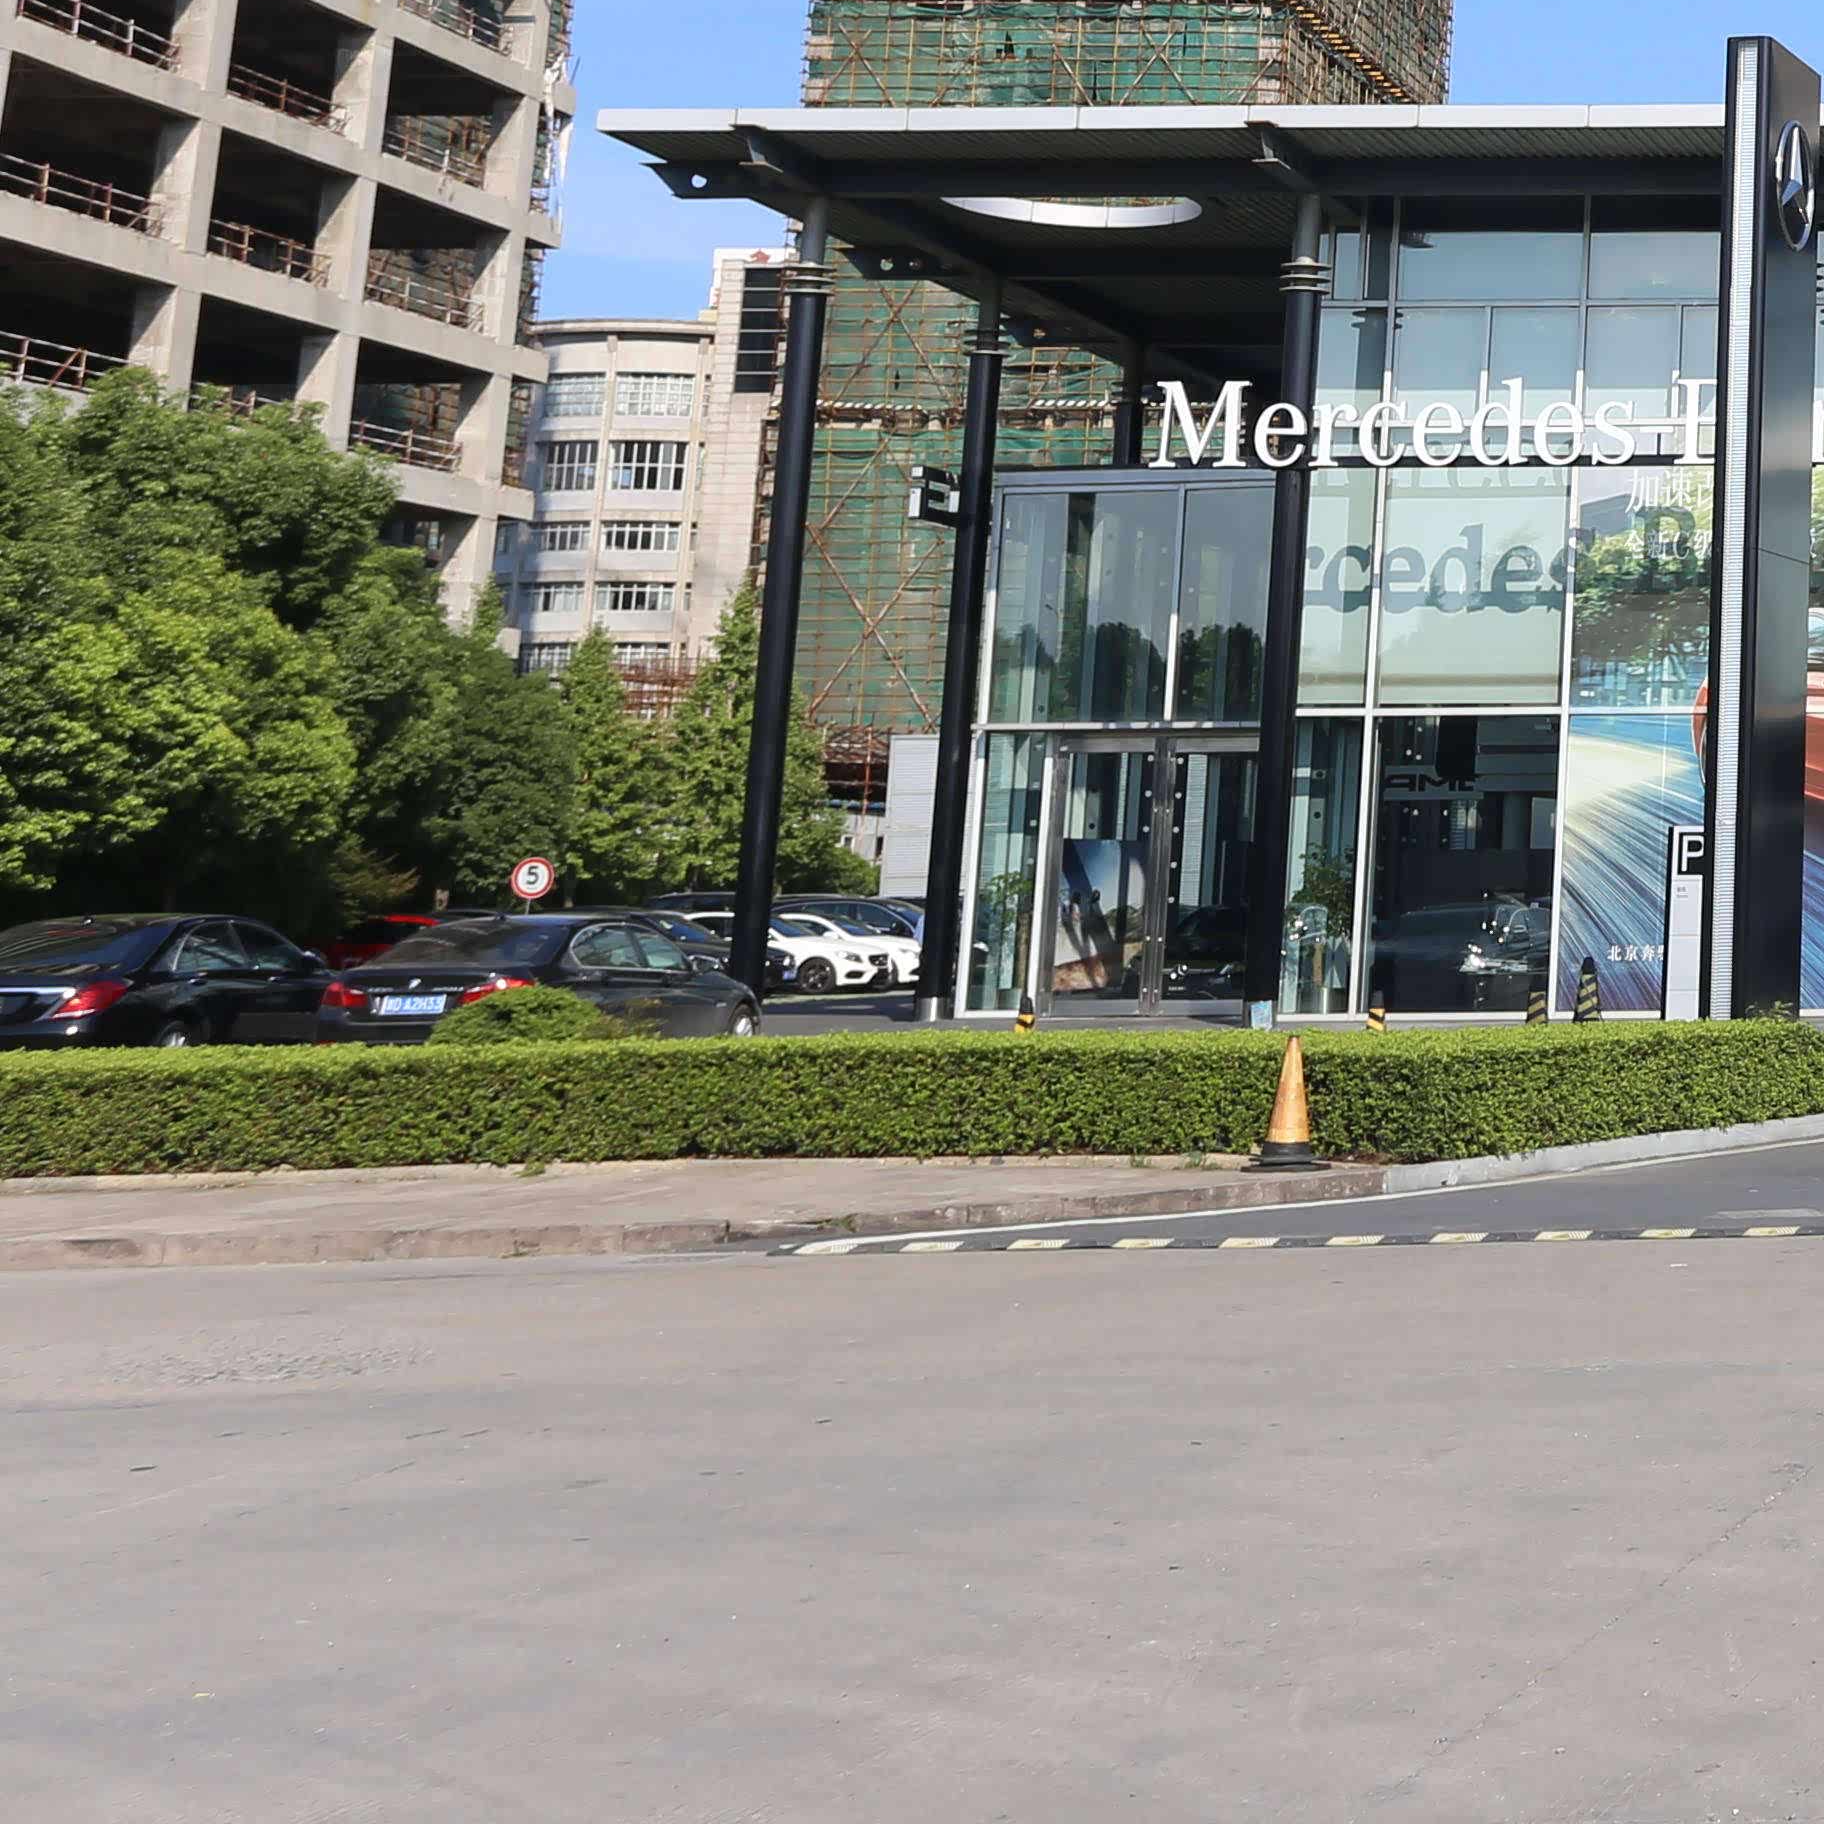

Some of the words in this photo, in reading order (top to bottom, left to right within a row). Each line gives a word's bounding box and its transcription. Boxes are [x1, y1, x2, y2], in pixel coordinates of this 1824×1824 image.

[1625, 468, 1714, 513] 加速
[1681, 835, 1704, 872] P
[527, 866, 539, 885] 5
[1607, 944, 1664, 962] 北京奔
